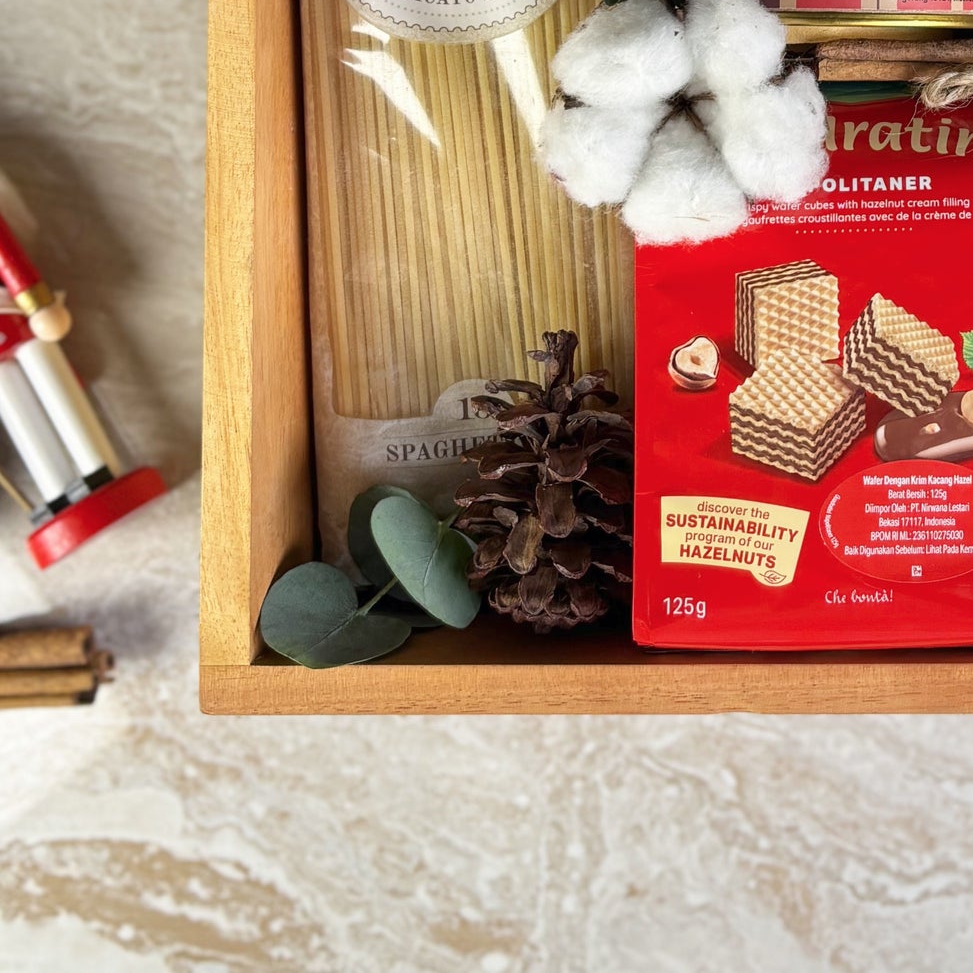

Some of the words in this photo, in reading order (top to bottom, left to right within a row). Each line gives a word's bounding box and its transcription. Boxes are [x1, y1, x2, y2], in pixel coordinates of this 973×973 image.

[822, 176, 932, 193] OLITANER
[804, 201, 834, 210] cubes
[837, 200, 858, 209] with
[861, 199, 905, 209] hazelnut
[907, 198, 940, 208] cream
[942, 197, 970, 209] filling
[798, 212, 867, 223] croustillantes
[869, 212, 894, 221] avec
[896, 211, 909, 221] de
[924, 210, 956, 220] crème
[959, 210, 971, 219] de
[863, 476, 883, 485] Wafer
[884, 476, 910, 486] Dengan
[911, 476, 927, 485] Krim
[928, 476, 952, 486] Kacang
[954, 475, 972, 485] Hazel
[888, 490, 905, 499] Berat
[906, 490, 925, 498] Bersih
[931, 489, 947, 500] 125g
[697, 502, 748, 515] discover
[751, 507, 770, 519] the
[891, 504, 906, 513] Oleh
[921, 503, 947, 512] Nirwana
[949, 502, 969, 512] Lestari
[666, 514, 798, 543] SUSTAINABILITY
[879, 517, 900, 527] Bekasi
[925, 517, 955, 526] Indonesia
[685, 532, 735, 545] program
[739, 537, 751, 546] of
[754, 542, 774, 550] our
[871, 532, 891, 541] BPOM
[680, 544, 776, 569] HAZELNUTS
[844, 546, 858, 555] Baik
[860, 546, 894, 557] Digunakan
[926, 545, 942, 554] Lihat
[943, 545, 959, 554] Pada
[663, 597, 706, 619] 125g
